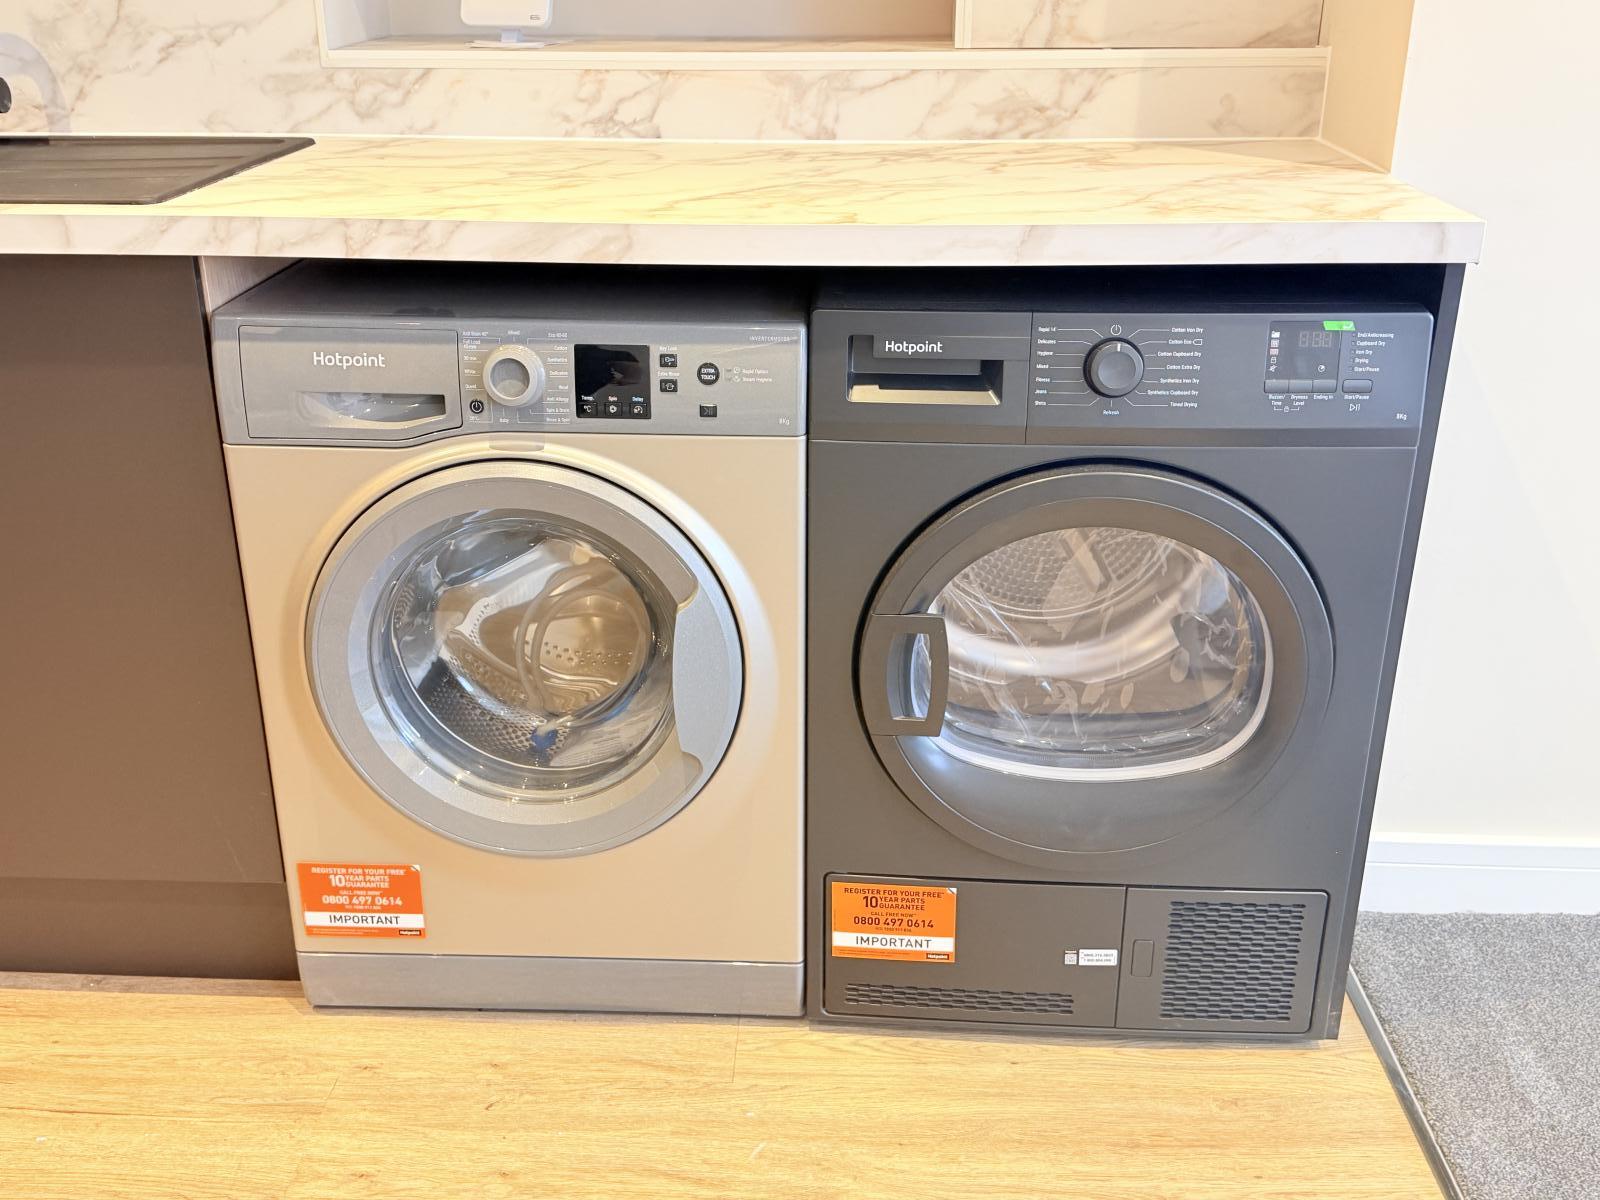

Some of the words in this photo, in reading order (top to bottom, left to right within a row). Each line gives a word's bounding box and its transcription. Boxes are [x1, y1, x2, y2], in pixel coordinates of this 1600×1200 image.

[886, 340, 943, 355] Hotpoint
[313, 352, 386, 370] Hotpoint
[329, 874, 346, 887] 10
[322, 895, 349, 904] 0800
[352, 896, 372, 905] 497
[374, 896, 402, 906] 0614
[862, 896, 878, 908] 10
[329, 914, 400, 924] IMPORTANT
[854, 916, 880, 925] 0800
[884, 918, 904, 926] 497
[906, 919, 934, 928] 0614
[856, 936, 932, 948] IMPORTANT
